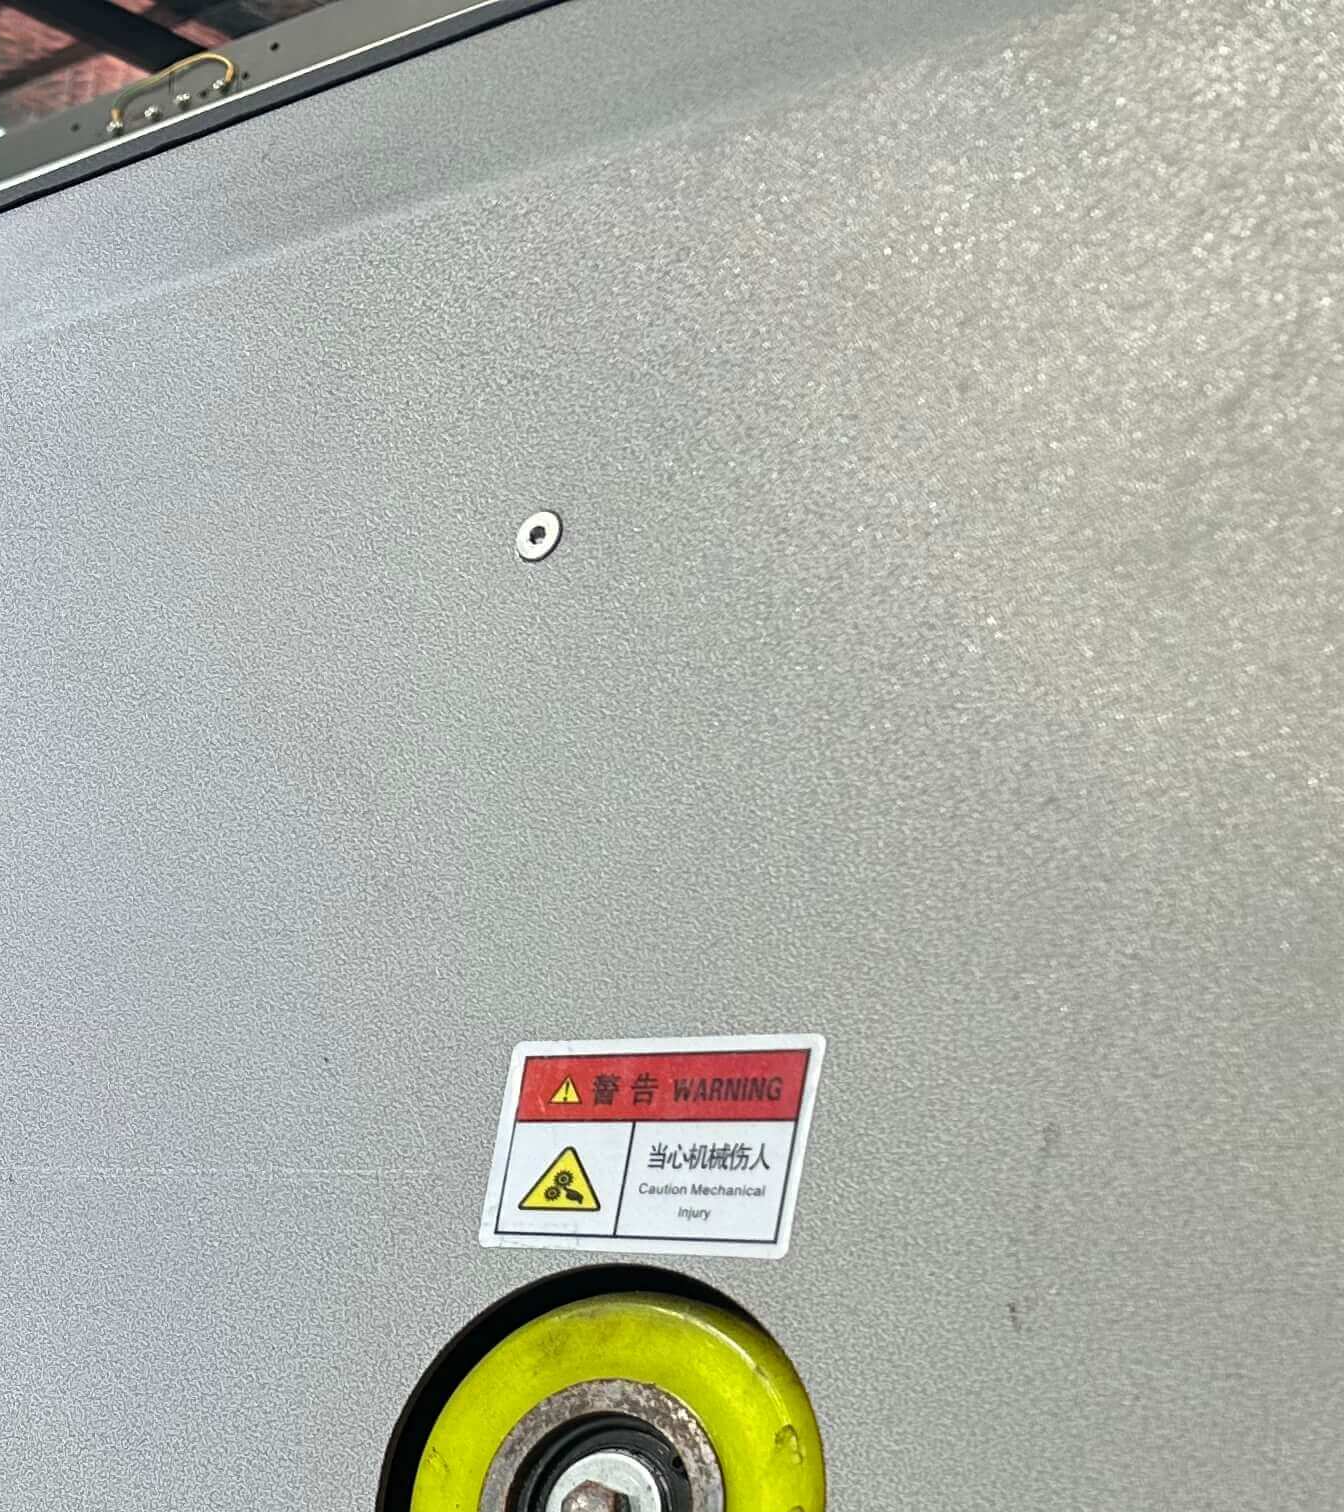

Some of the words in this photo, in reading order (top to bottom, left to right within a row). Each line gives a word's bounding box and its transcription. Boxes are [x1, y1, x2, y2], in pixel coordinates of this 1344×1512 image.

[672, 1077, 784, 1101] WARNING
[647, 1142, 771, 1171] 当心机械伤人
[638, 1182, 688, 1197] Caution
[690, 1183, 766, 1198] Mechanical
[677, 1207, 712, 1221] Injury
